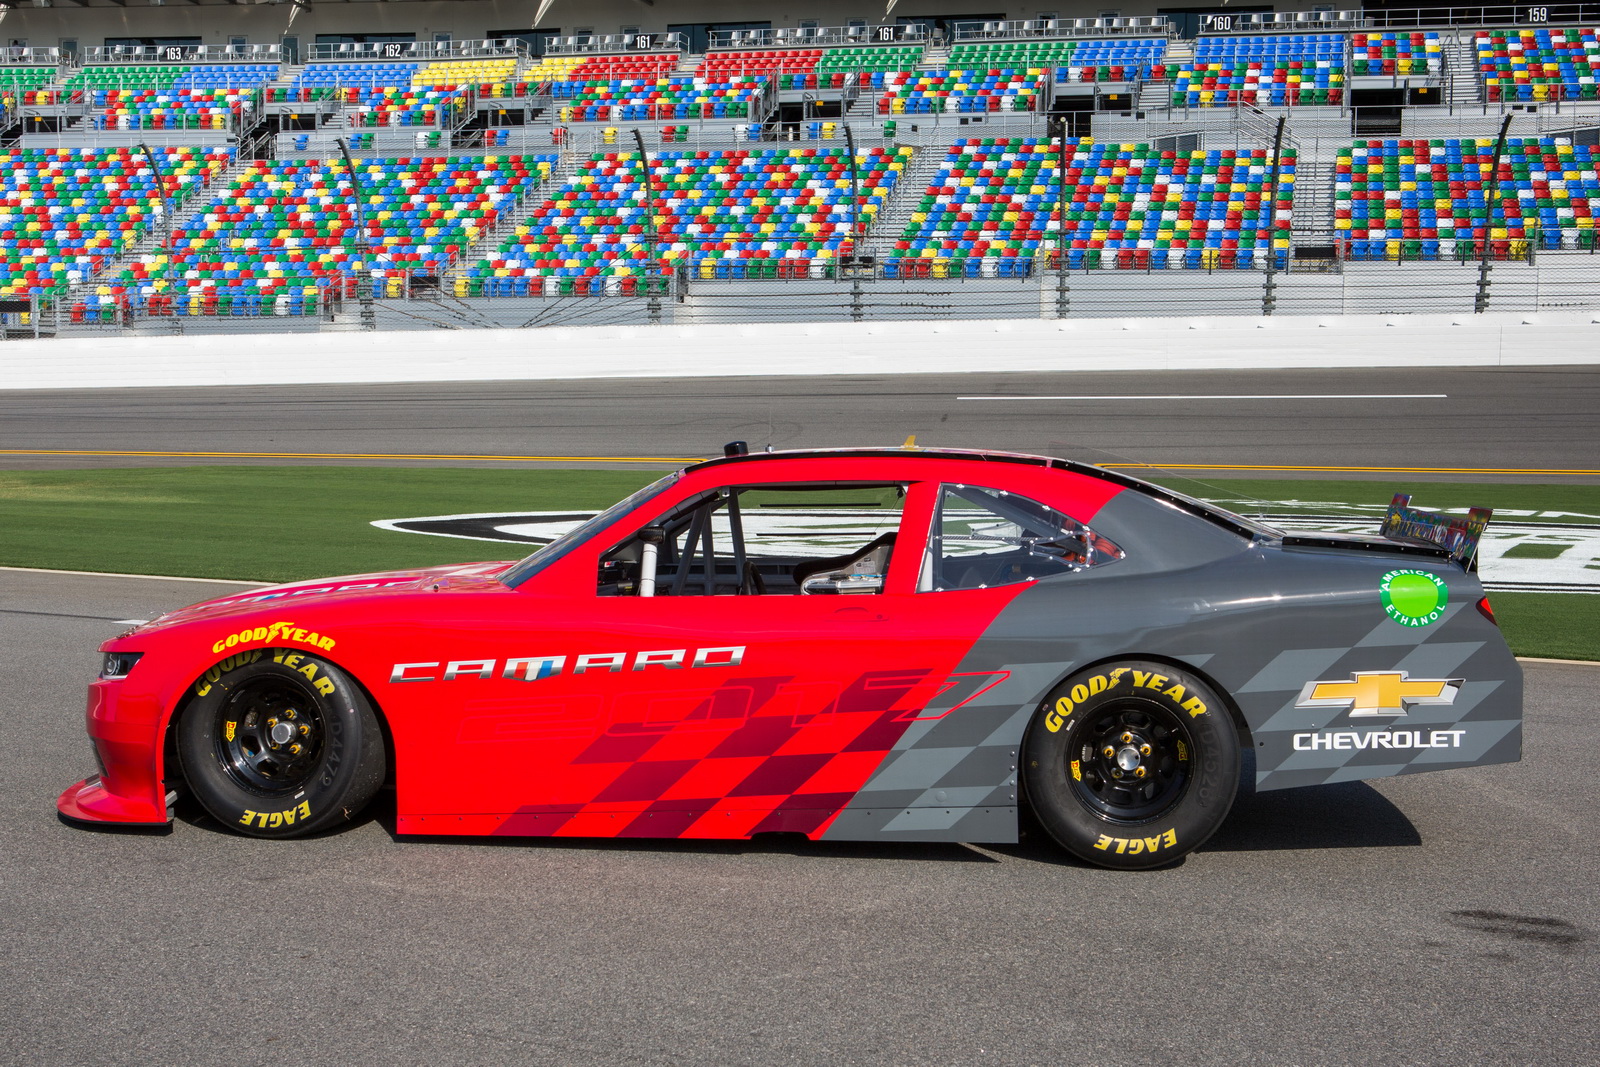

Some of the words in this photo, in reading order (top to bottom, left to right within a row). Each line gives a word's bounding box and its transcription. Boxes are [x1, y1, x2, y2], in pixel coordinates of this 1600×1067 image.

[1213, 16, 1231, 31] 160
[1528, 7, 1547, 22] 159
[636, 35, 650, 49] 161
[879, 27, 894, 41] 161
[166, 47, 182, 60] 163
[385, 44, 401, 57] 162
[1383, 569, 1444, 592] AMERICAN
[1386, 604, 1446, 626] ETHANOL
[389, 645, 747, 683] CAMARO
[1293, 730, 1466, 751] CHEVROLET
[239, 799, 312, 828] EAGLE
[1093, 827, 1178, 855] EAGLE
